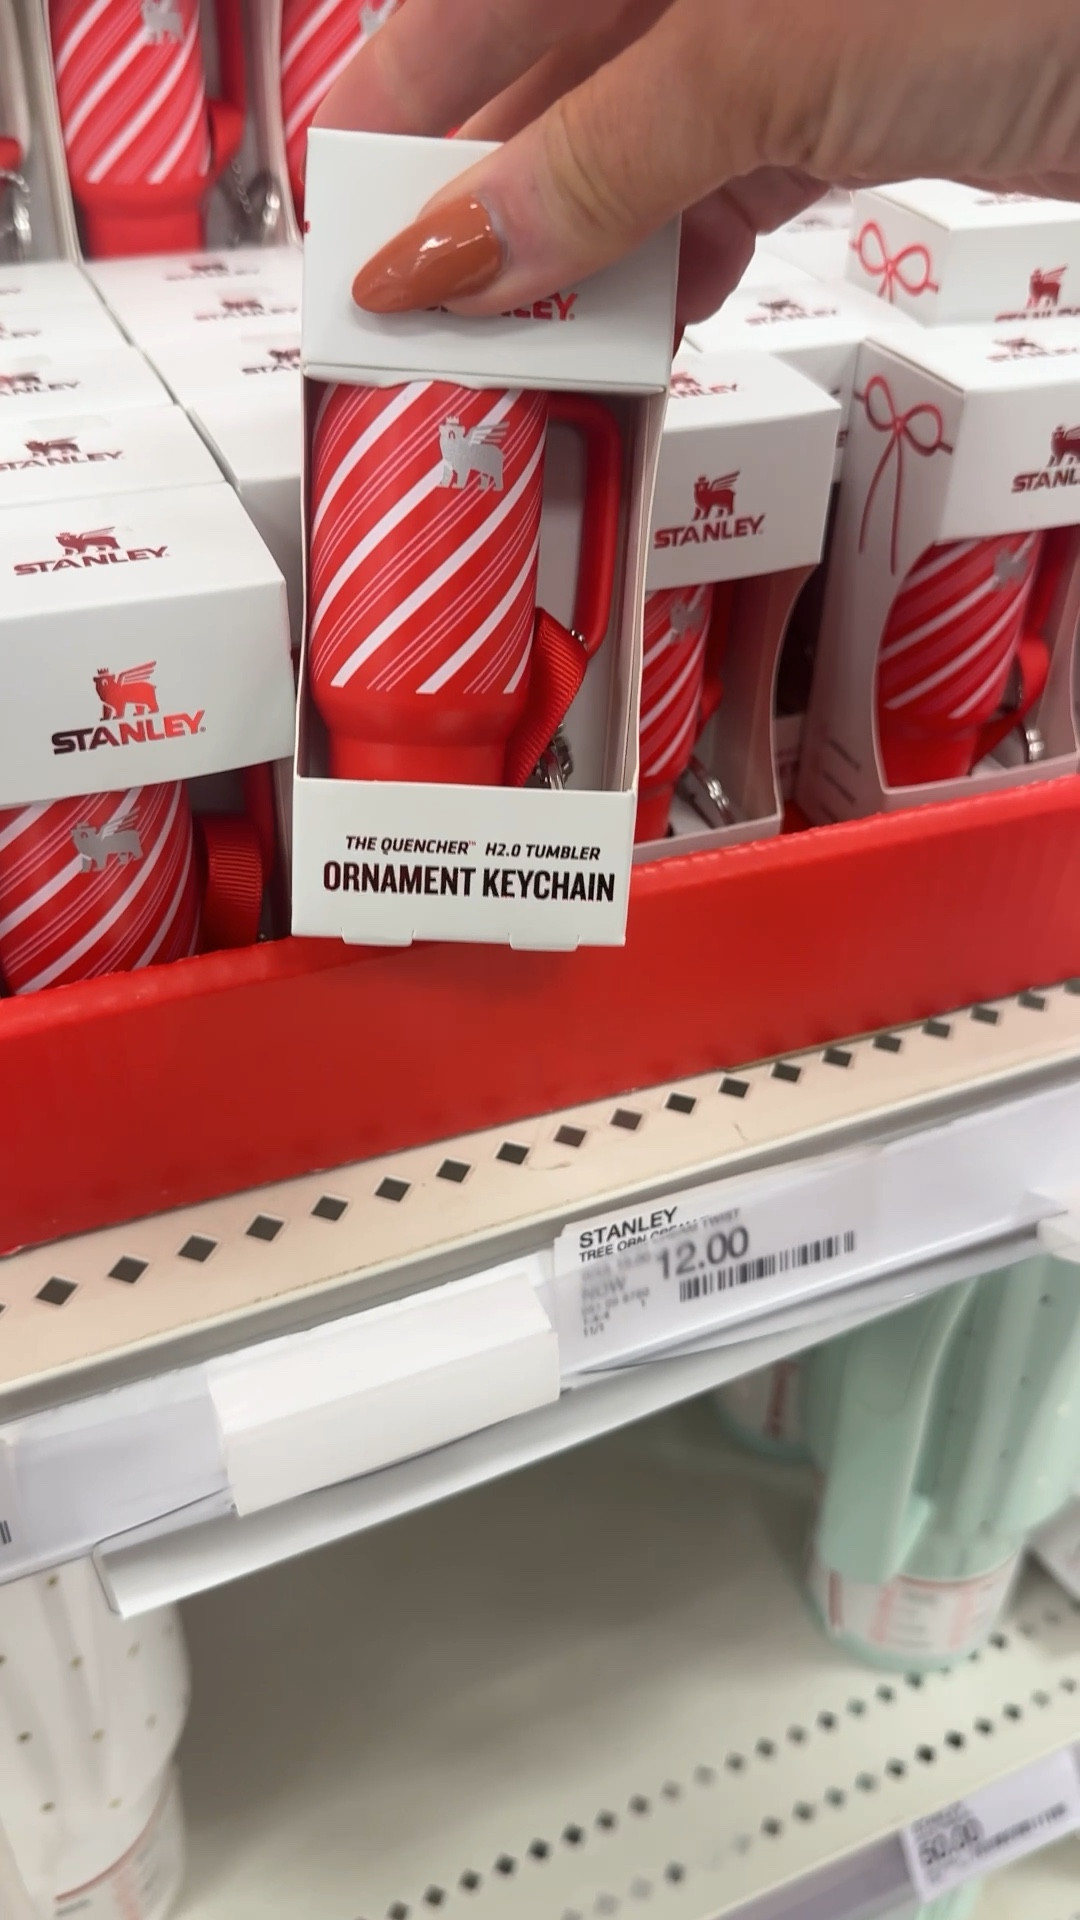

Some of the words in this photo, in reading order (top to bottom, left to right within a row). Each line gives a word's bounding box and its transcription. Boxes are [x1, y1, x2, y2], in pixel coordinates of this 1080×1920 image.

[653, 513, 766, 550] STANLEY
[13, 546, 168, 576] STANLEY
[51, 710, 206, 755] STANLEY
[345, 835, 378, 851] THE
[485, 842, 521, 857] H2.0
[525, 844, 601, 861] TUMBLER
[323, 861, 476, 897] ORNAMENT
[482, 868, 615, 902] KEYCHAIN
[579, 1206, 678, 1250] STANLEY
[578, 1244, 614, 1263] TREE
[656, 1225, 750, 1281] 12.00
